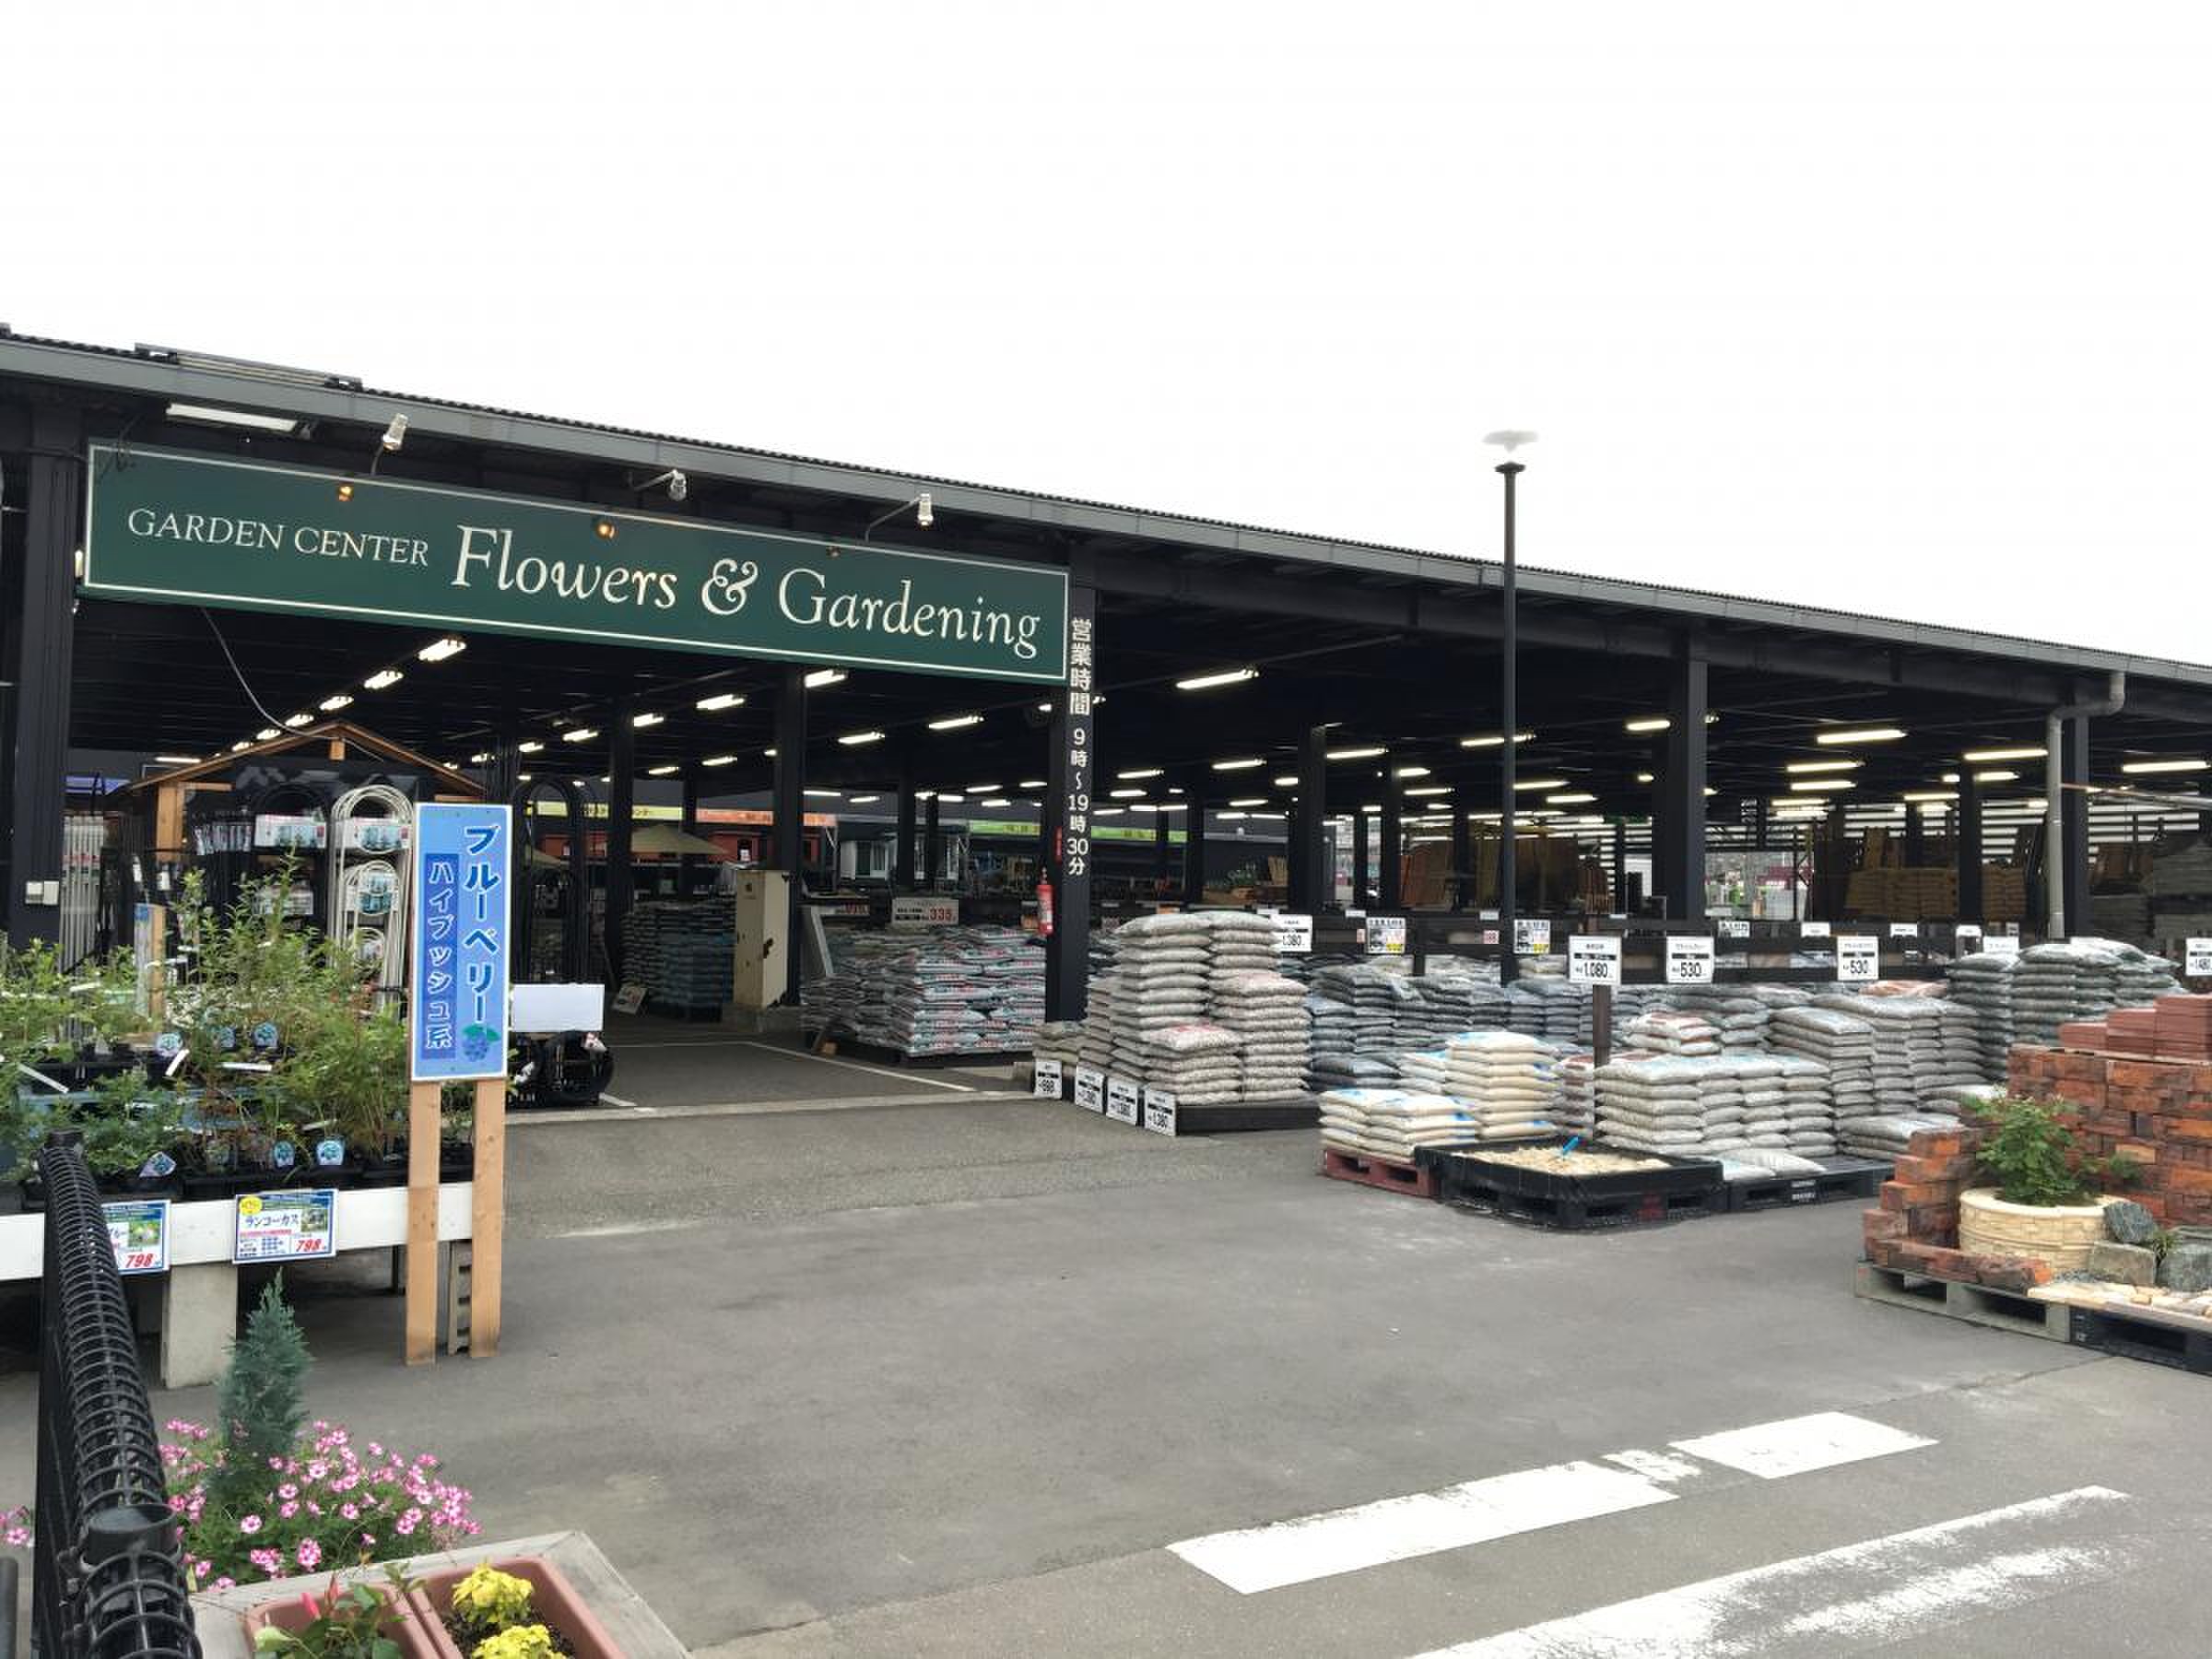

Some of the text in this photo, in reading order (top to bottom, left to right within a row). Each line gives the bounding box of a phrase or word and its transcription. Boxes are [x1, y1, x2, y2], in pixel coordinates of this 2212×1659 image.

[127, 508, 1041, 660] GARDEN CENTER Flowers & Gardening
[1069, 617, 1092, 716] 営業時間
[463, 824, 500, 1024] ブルーベリー
[425, 861, 455, 1050] ハイブッシュ系
[1680, 961, 1702, 978] 530
[1850, 959, 1869, 974] 530
[125, 1253, 154, 1269] 798
[295, 1238, 324, 1253] 798
